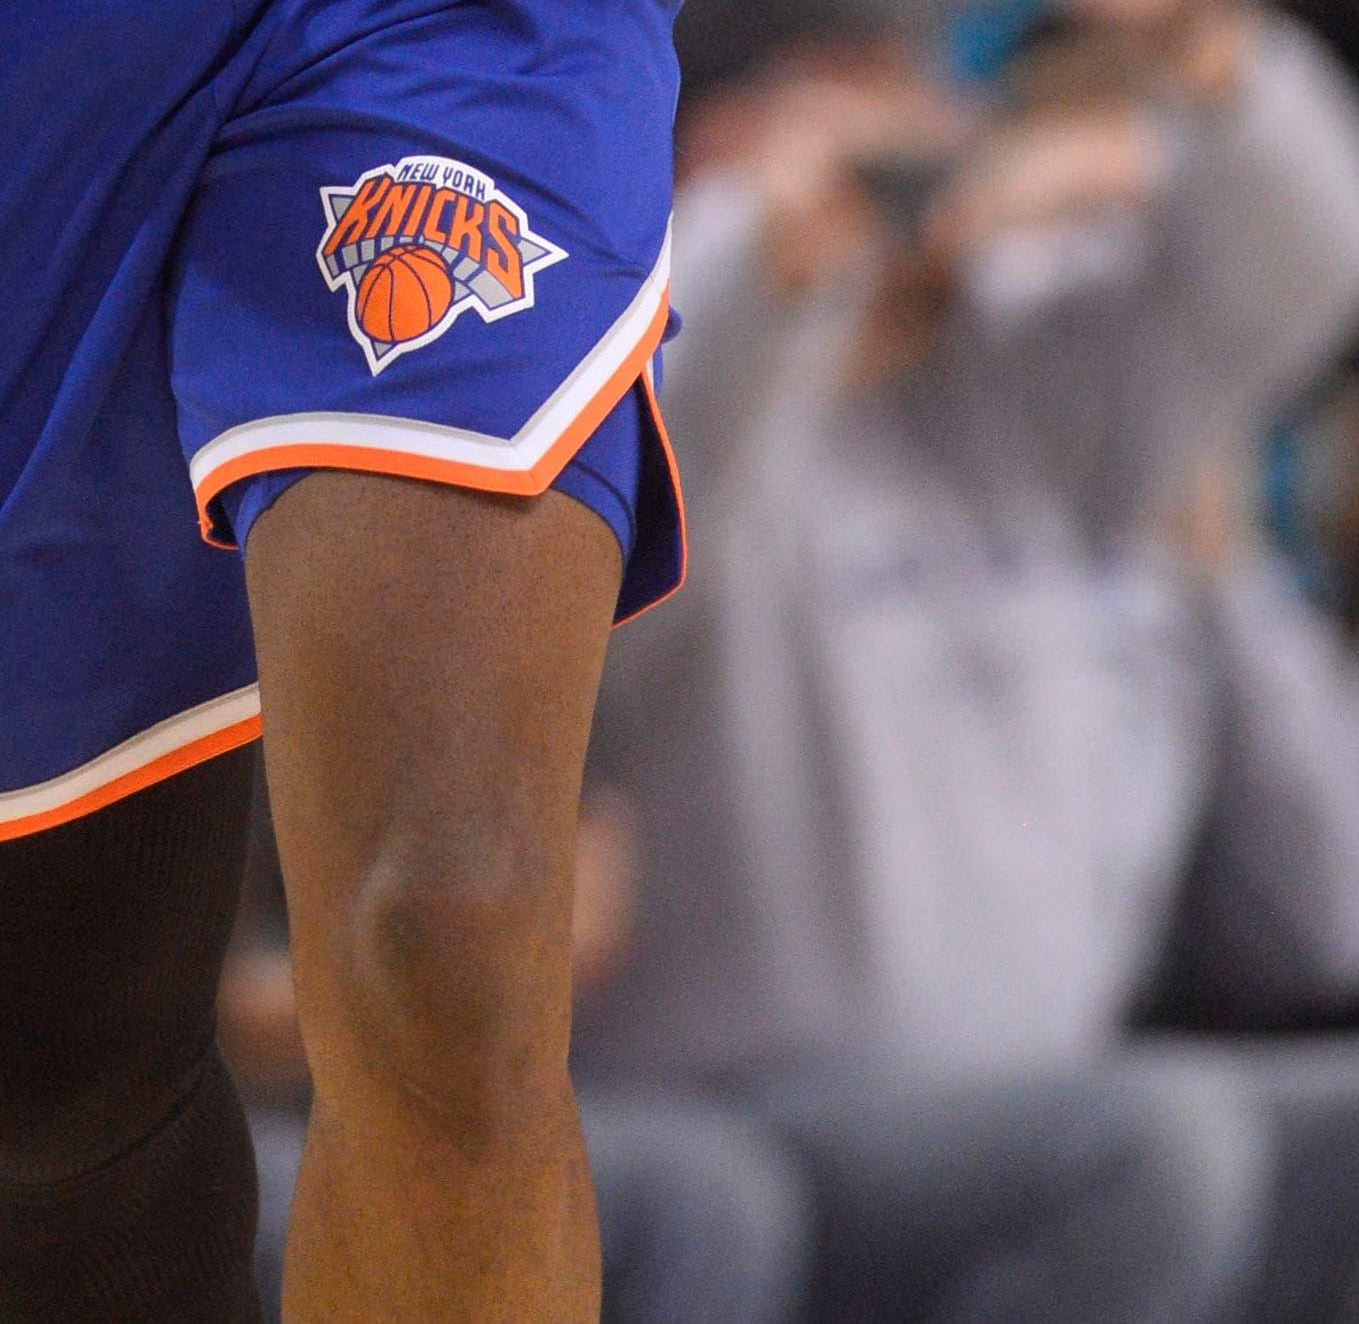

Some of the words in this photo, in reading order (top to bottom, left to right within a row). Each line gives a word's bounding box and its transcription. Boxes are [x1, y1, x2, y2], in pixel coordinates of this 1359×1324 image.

[397, 163, 440, 181] NEW
[442, 167, 486, 201] YORK
[322, 172, 524, 299] KNICKS
